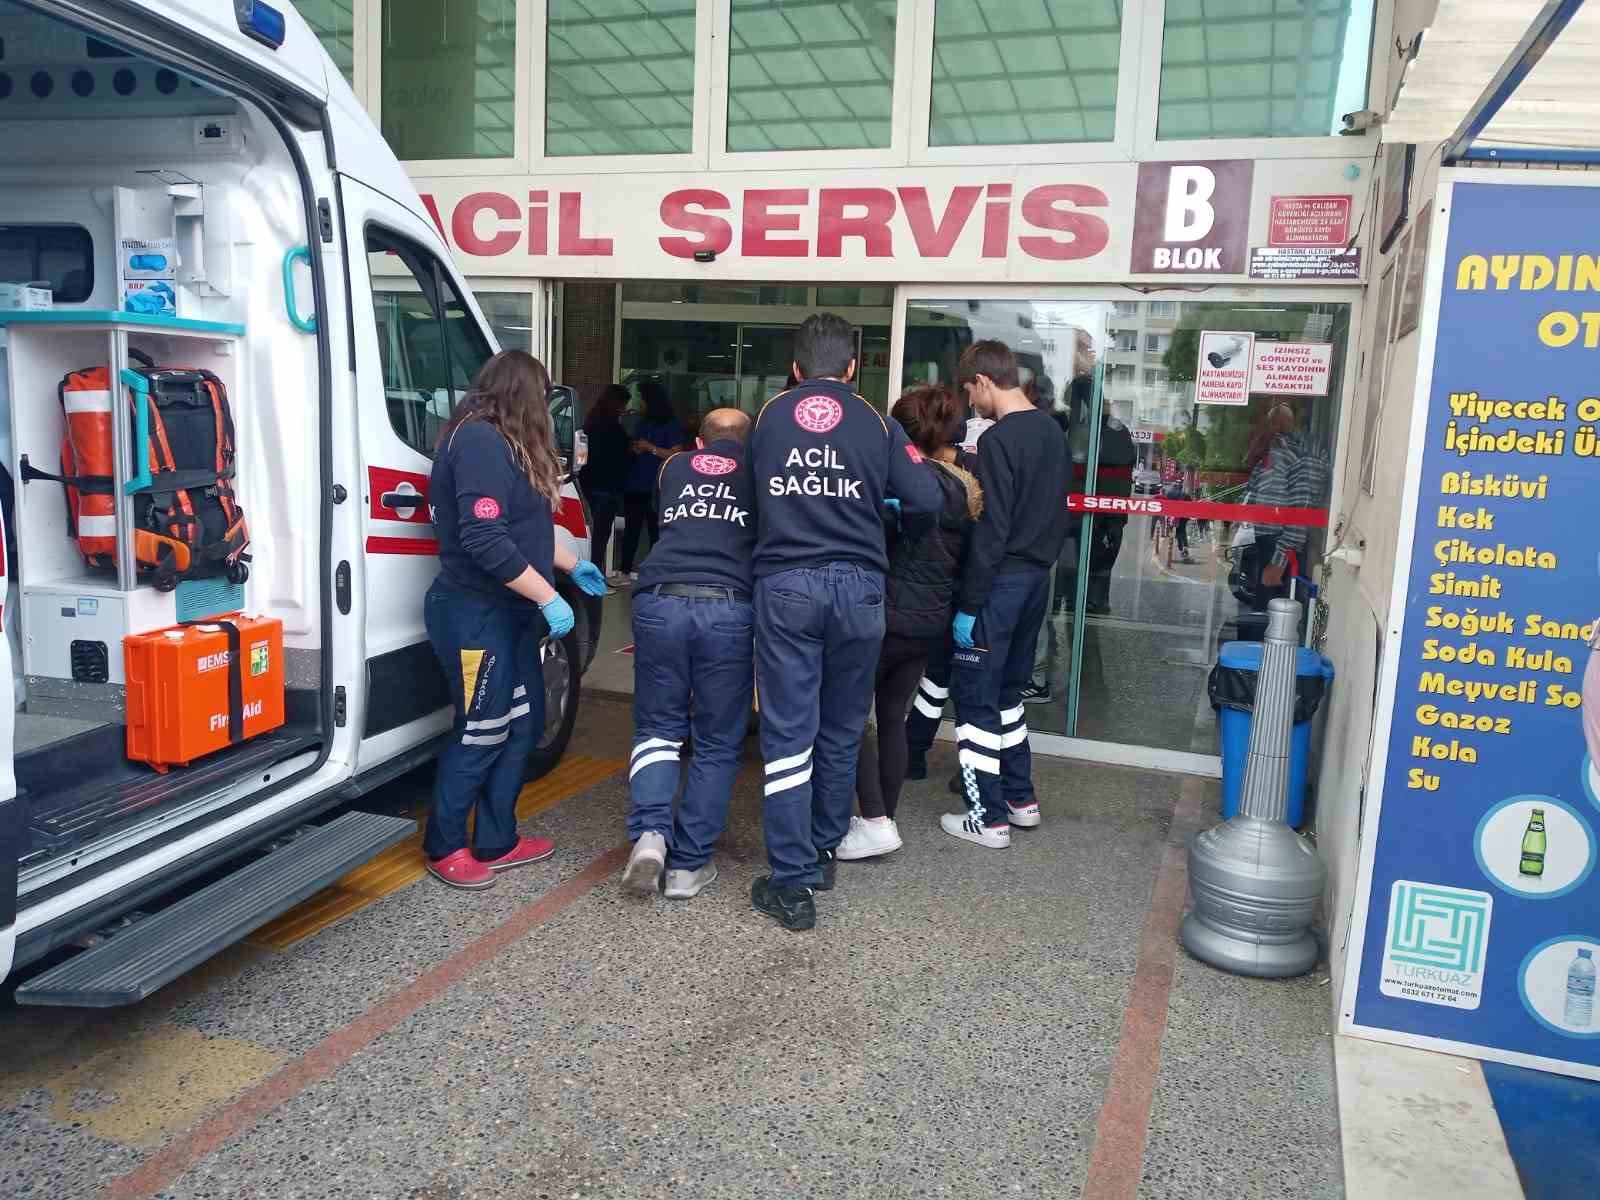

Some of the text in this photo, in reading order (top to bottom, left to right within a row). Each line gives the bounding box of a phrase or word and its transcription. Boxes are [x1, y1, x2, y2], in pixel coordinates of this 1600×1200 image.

[1163, 165, 1216, 242] B
[1153, 246, 1222, 270] BLOK
[1449, 392, 1567, 423] Yiyecek
[1445, 420, 1566, 456] İçindeki
[785, 444, 845, 470] ACİL
[678, 482, 737, 500] ACİL
[769, 471, 863, 499] SAĞLIK
[1440, 471, 1548, 499] Bisküvi
[663, 498, 750, 527] SAĞLIK
[1437, 506, 1495, 530] Kek
[1434, 539, 1557, 569] Çikolata
[1429, 572, 1502, 599] Simit
[1425, 606, 1515, 636] Soğuk
[1422, 639, 1573, 673] Soda Kula
[1418, 671, 1537, 703] Meyveli
[242, 700, 262, 720] Aid
[1415, 704, 1512, 734] Gazoz
[1411, 736, 1478, 763] Kola
[1407, 768, 1440, 791] Su
